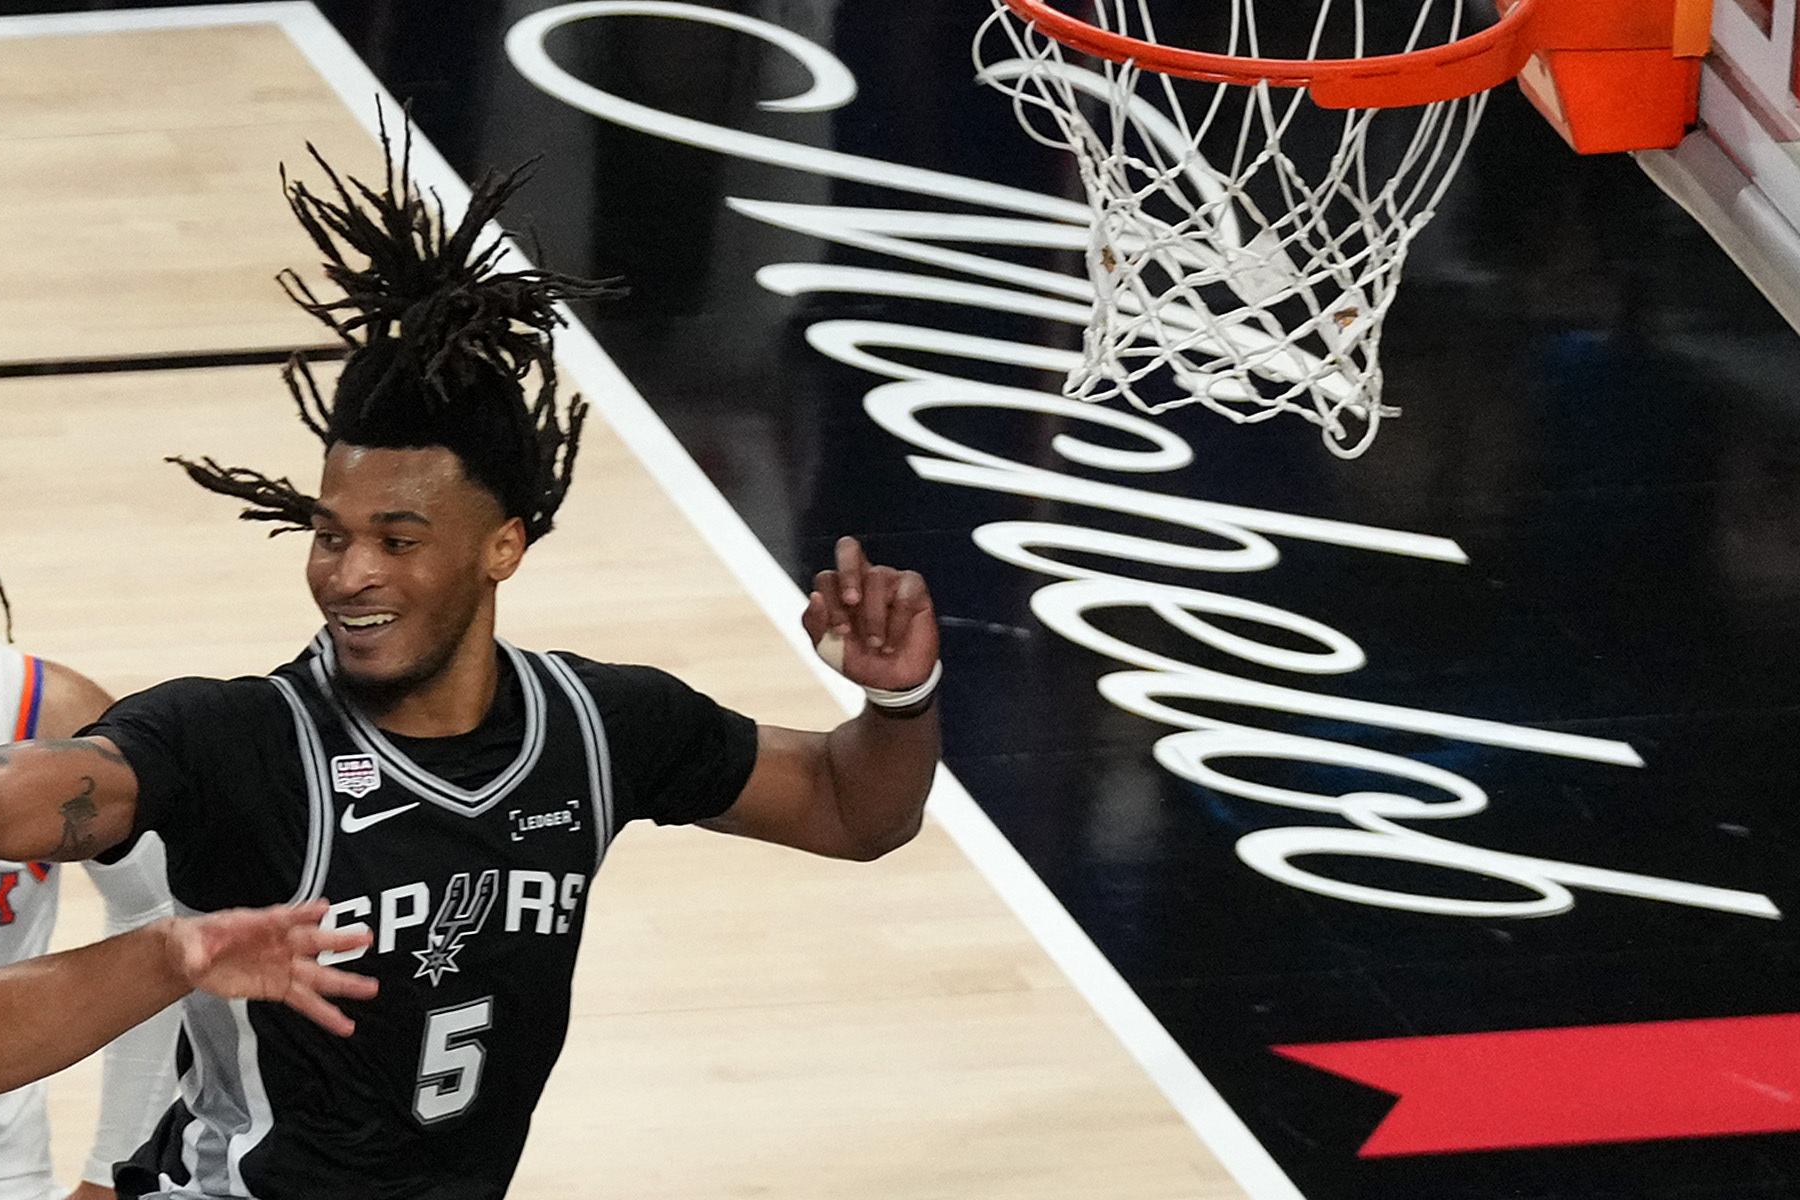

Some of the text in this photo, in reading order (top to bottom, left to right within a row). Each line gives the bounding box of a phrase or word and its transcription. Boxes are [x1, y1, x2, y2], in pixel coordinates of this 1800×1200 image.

[504, 0, 1783, 919] Michelob
[518, 809, 573, 832] LEDGER
[412, 995, 494, 1126] 5
